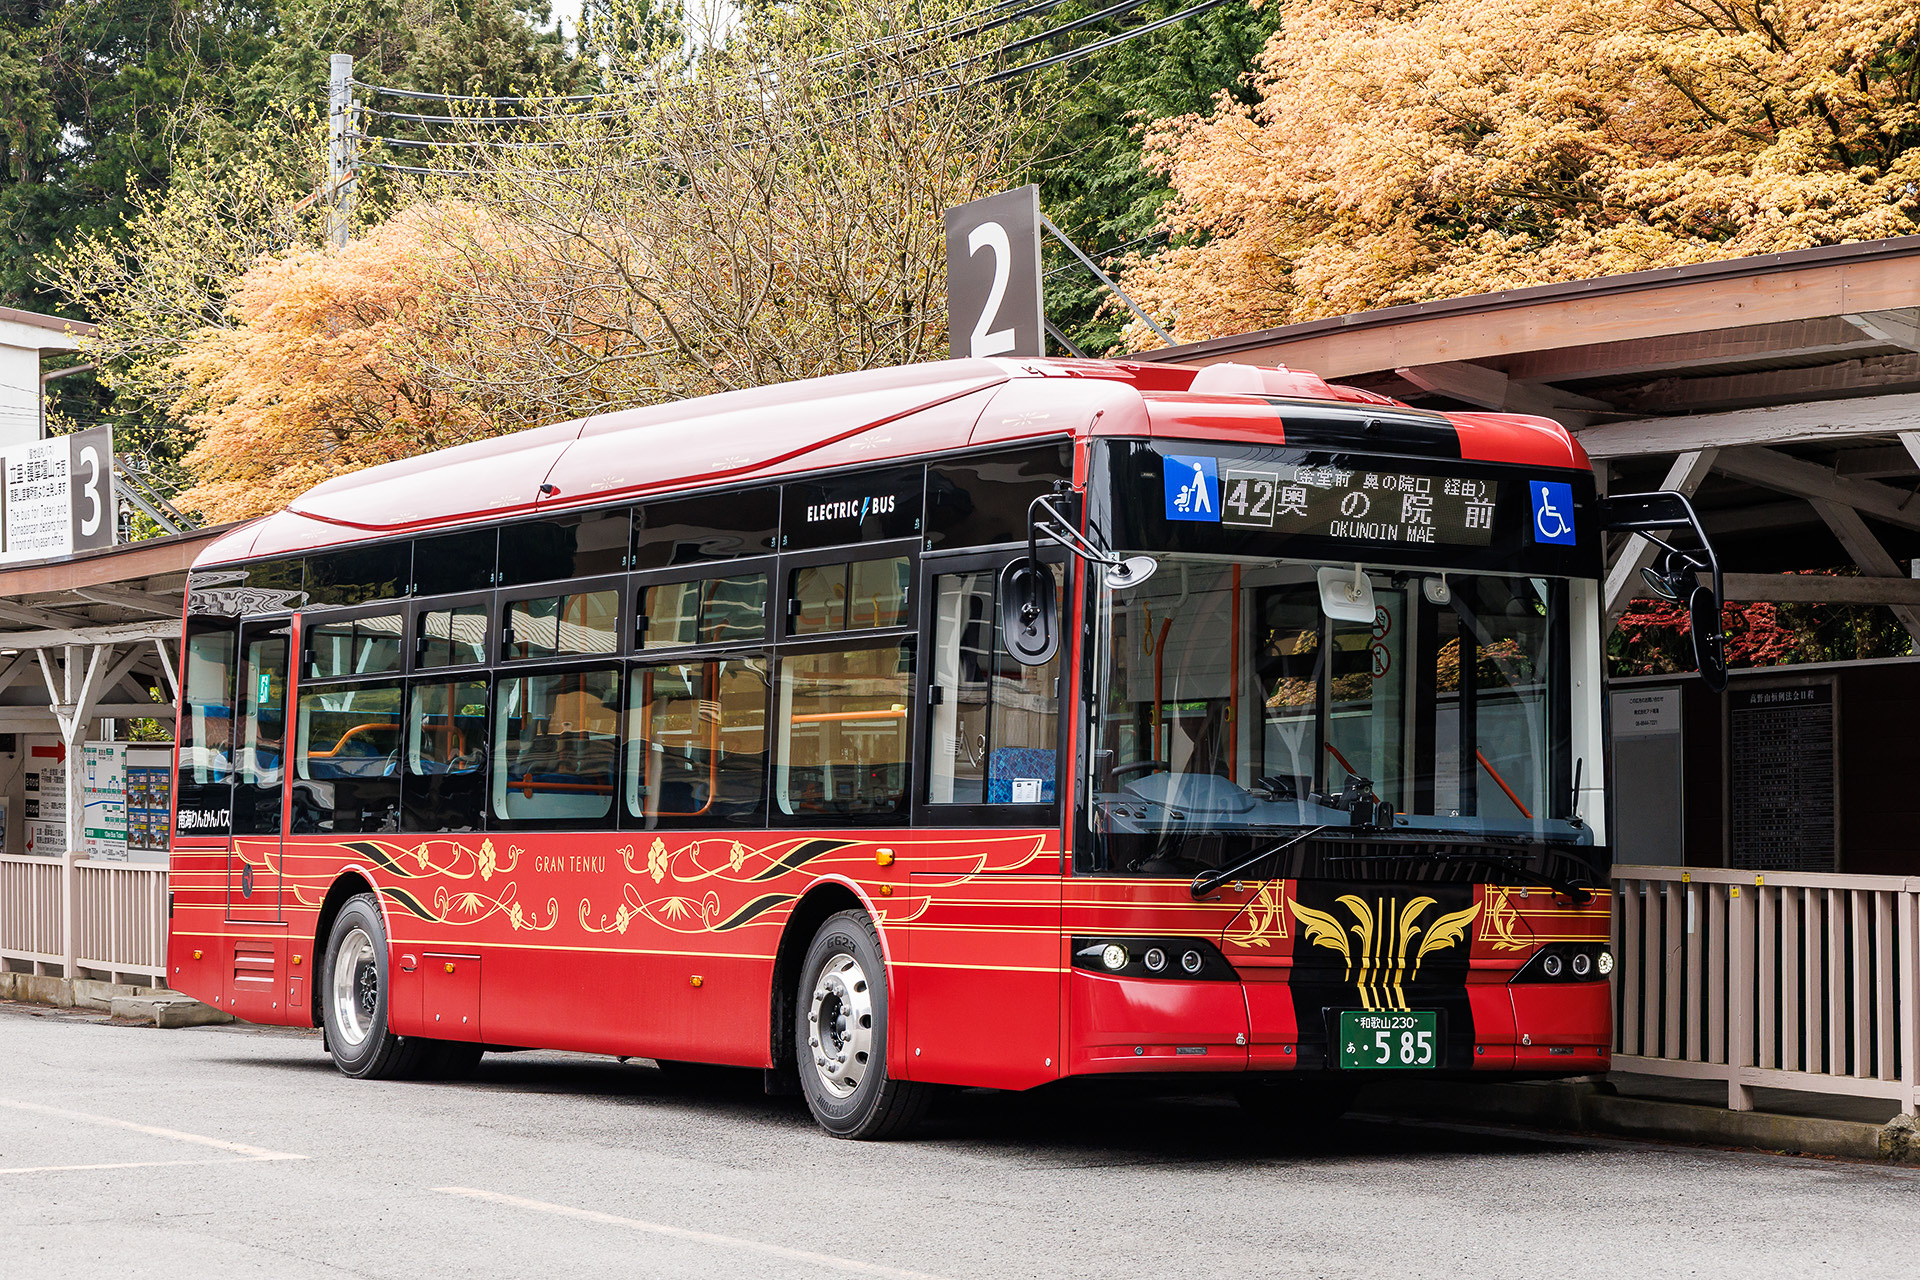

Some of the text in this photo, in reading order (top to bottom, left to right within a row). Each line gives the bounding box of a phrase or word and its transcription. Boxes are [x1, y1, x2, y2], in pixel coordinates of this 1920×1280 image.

[968, 221, 1015, 358] 2
[80, 446, 101, 537] 3
[1363, 473, 1431, 494] 奥の院口
[806, 494, 896, 522] ELECTRIC BUS
[1227, 480, 1273, 517] 42
[1329, 520, 1437, 543] OKUNOIN MAE
[177, 808, 231, 830] 南海りんかんバス
[535, 855, 606, 874] GRAN TENKU
[827, 935, 857, 954] G623
[1360, 1016, 1414, 1029] 和歌山230
[1346, 1041, 1356, 1054] あ
